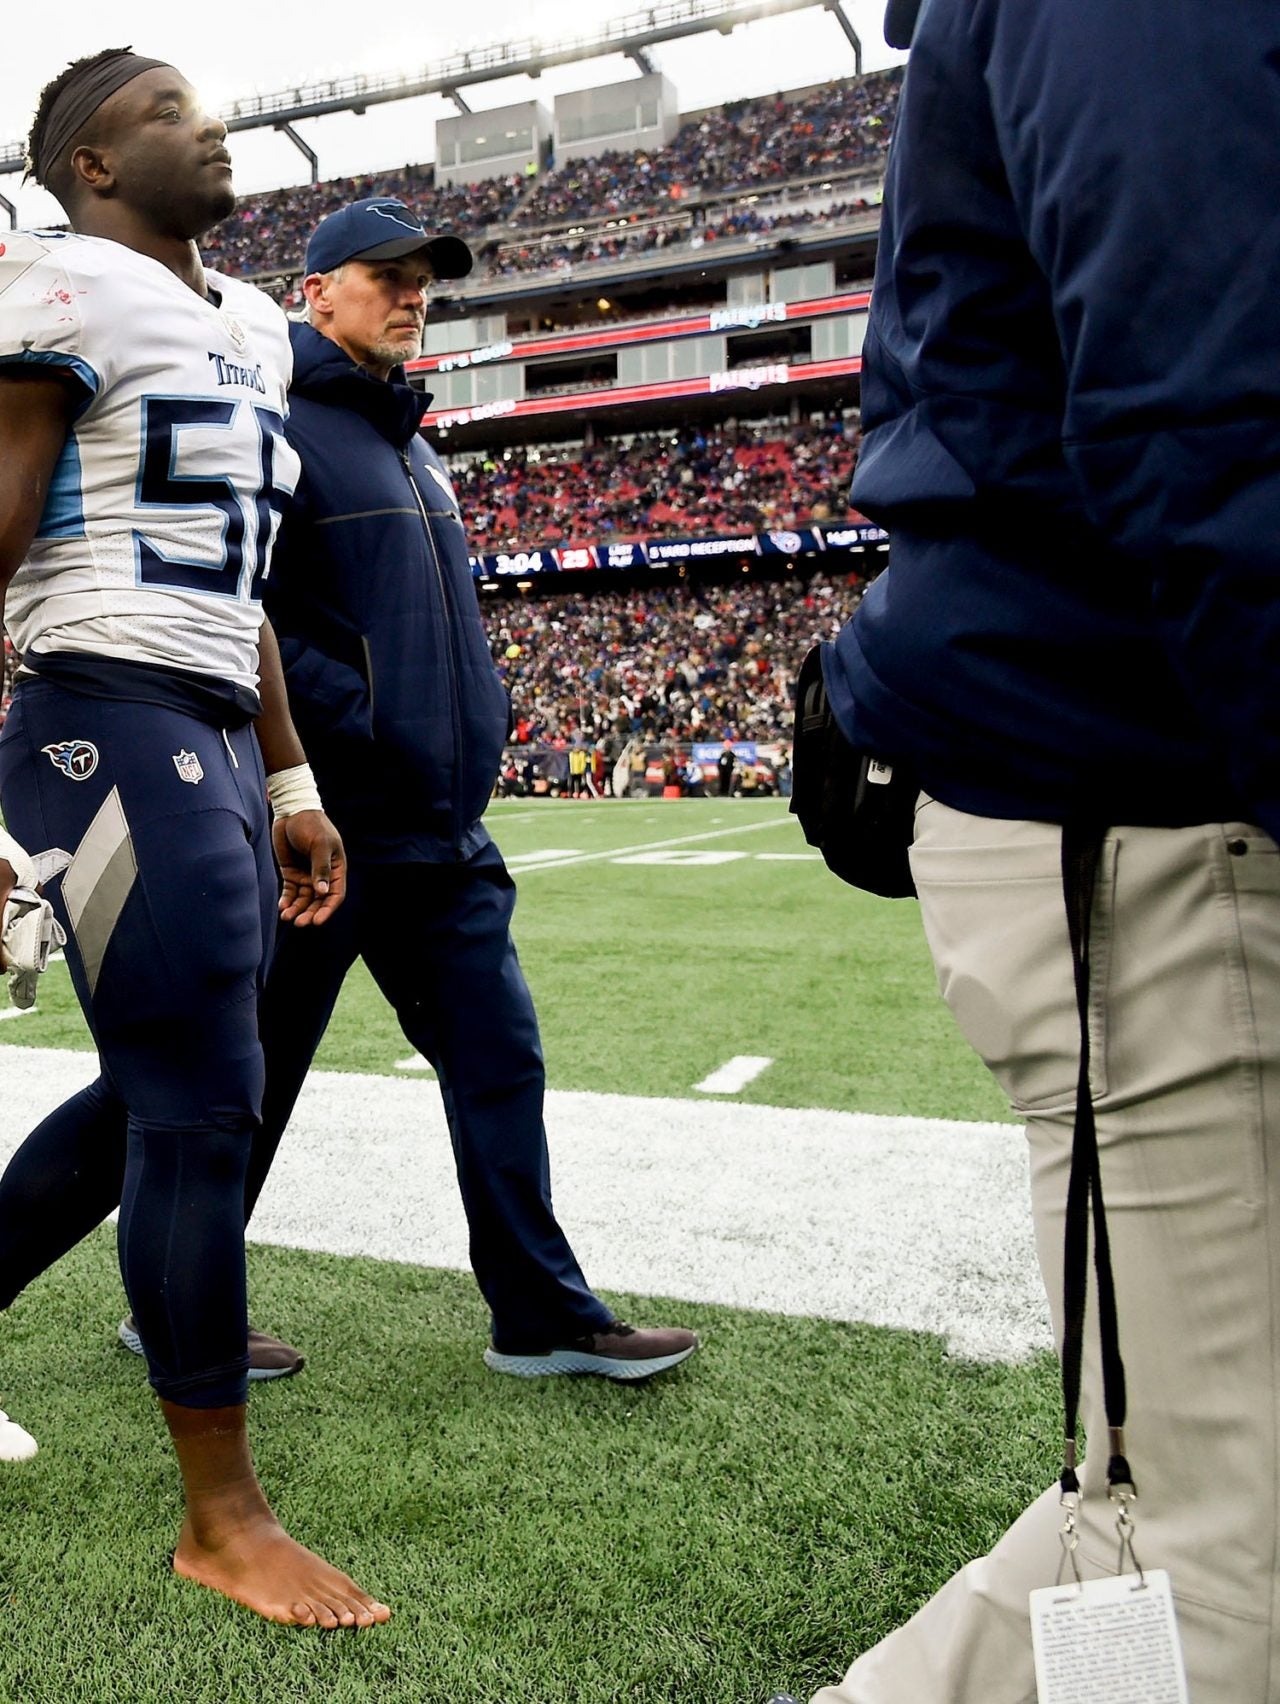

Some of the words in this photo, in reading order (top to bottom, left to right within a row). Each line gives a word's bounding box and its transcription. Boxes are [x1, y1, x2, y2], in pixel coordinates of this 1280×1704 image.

[691, 539, 755, 555] RECEPTION
[496, 552, 543, 574] 3:04
[182, 765, 200, 778] NFL
